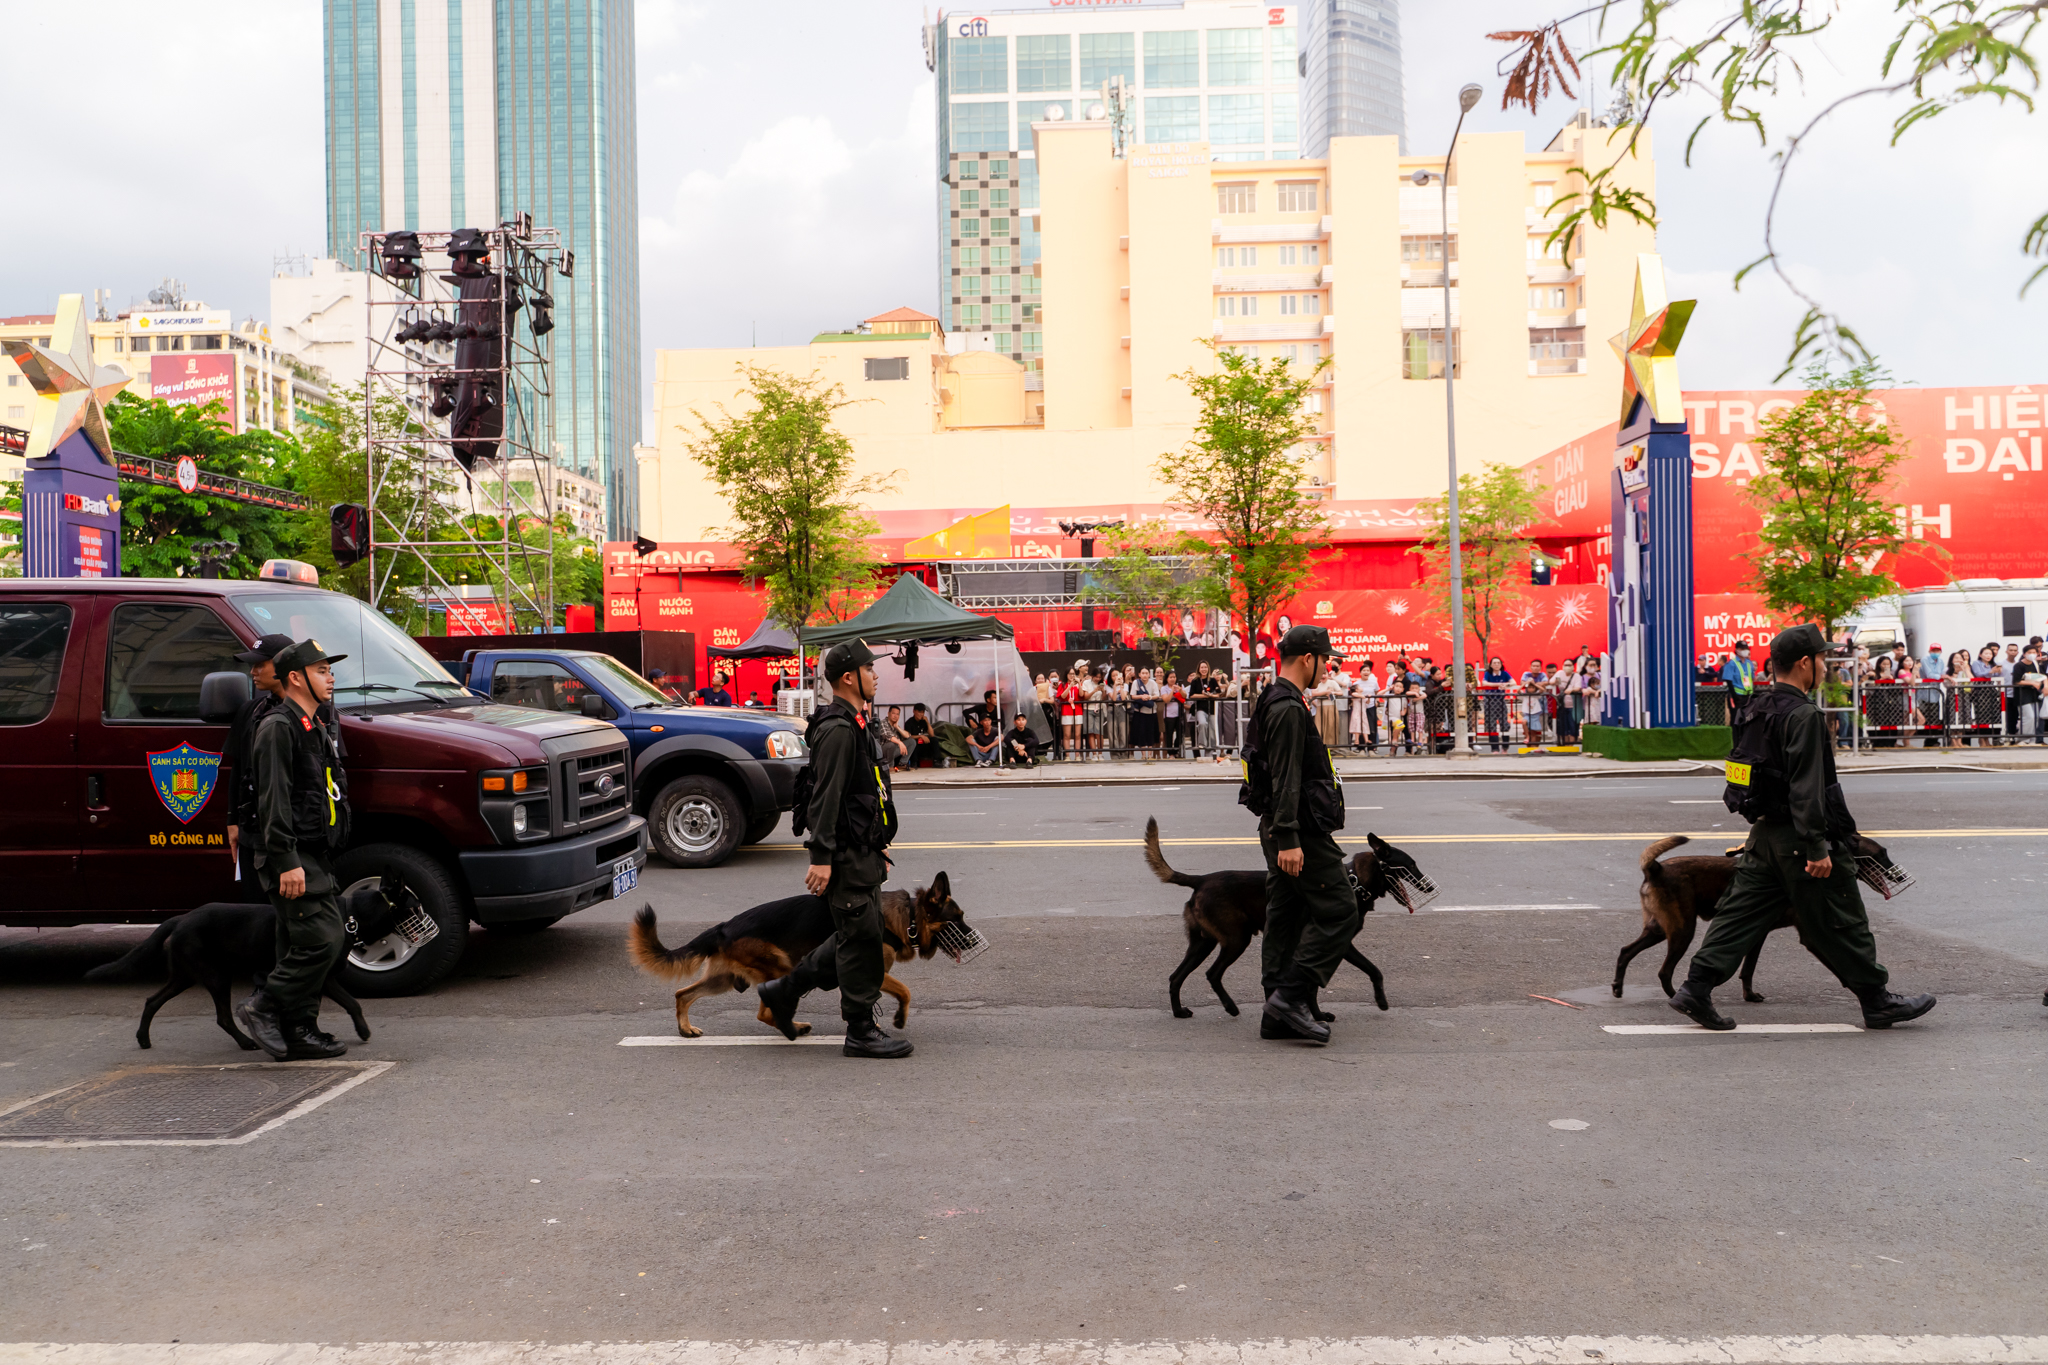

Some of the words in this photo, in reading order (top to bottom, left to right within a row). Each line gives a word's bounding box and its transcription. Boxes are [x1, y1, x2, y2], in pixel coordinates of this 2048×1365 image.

[959, 17, 988, 37] citi
[1149, 145, 1170, 155] KIM
[1132, 157, 1168, 168] ROYAL
[1171, 155, 1208, 166] HOTEL
[1148, 167, 1189, 179] SAIGON
[153, 317, 204, 325] SAIGONTOURIST
[184, 377, 207, 390] SỐNG
[1555, 444, 1584, 483] DÂN
[1943, 436, 2043, 481] ĐẠI
[1554, 477, 1588, 517] GIÀU
[64, 493, 109, 516] HDBank
[611, 598, 635, 607] DÂN
[659, 597, 692, 606] NƯỚC
[611, 606, 638, 616] GIÀU
[659, 607, 693, 617] MẠNH
[1703, 612, 1731, 630] MỸ
[1733, 612, 1771, 629] TÂM
[713, 627, 738, 637] DÂN
[713, 633, 741, 646] GIÀU
[1344, 635, 1387, 645] QUANG
[1704, 631, 1755, 648] TÙNG
[1349, 645, 1366, 653] AN
[1368, 642, 1401, 653] NHÂN
[1403, 641, 1429, 652] DÂN
[152, 755, 171, 766] CẢNH
[173, 755, 186, 766] SÁT
[187, 757, 198, 766] CƠ
[199, 755, 219, 767] ĐỘNG
[149, 831, 167, 848] BỘ
[170, 831, 204, 845] CÔNG
[207, 834, 224, 845] AN
